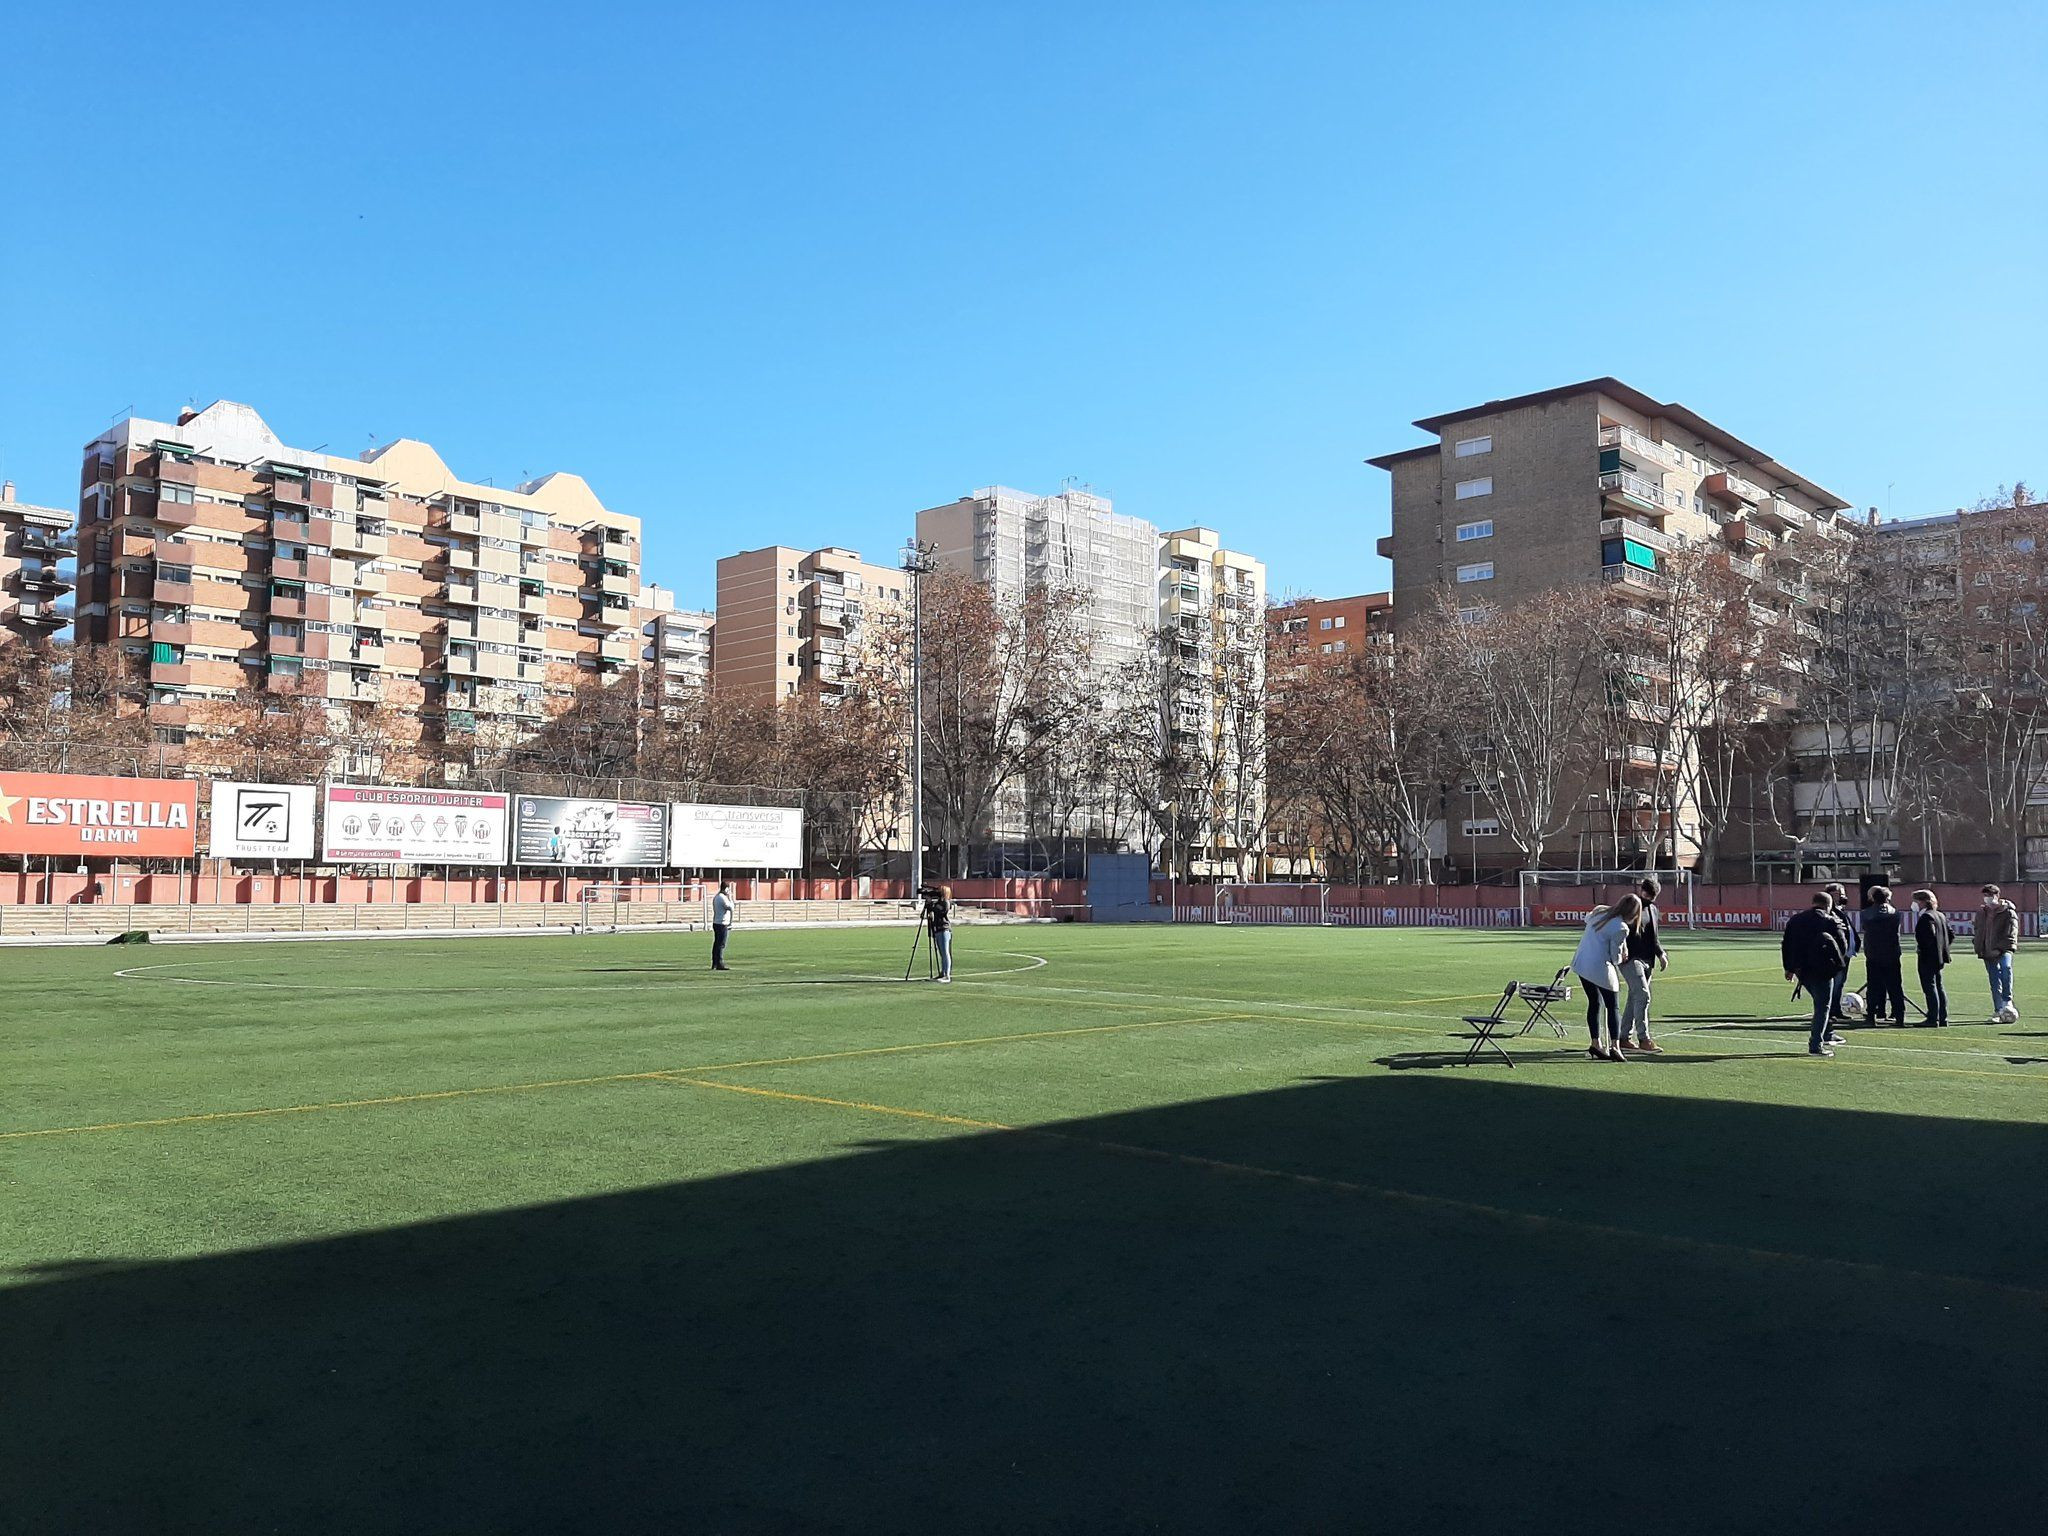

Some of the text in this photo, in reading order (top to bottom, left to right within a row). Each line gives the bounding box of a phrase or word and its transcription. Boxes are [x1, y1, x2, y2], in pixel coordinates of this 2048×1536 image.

[355, 791, 483, 806] CLUB ESPORTIU JUPITER
[27, 797, 188, 828] ESTRELLA
[81, 828, 138, 843] DAMM
[267, 845, 289, 853] TEAM
[1724, 912, 1762, 923] DAMM
